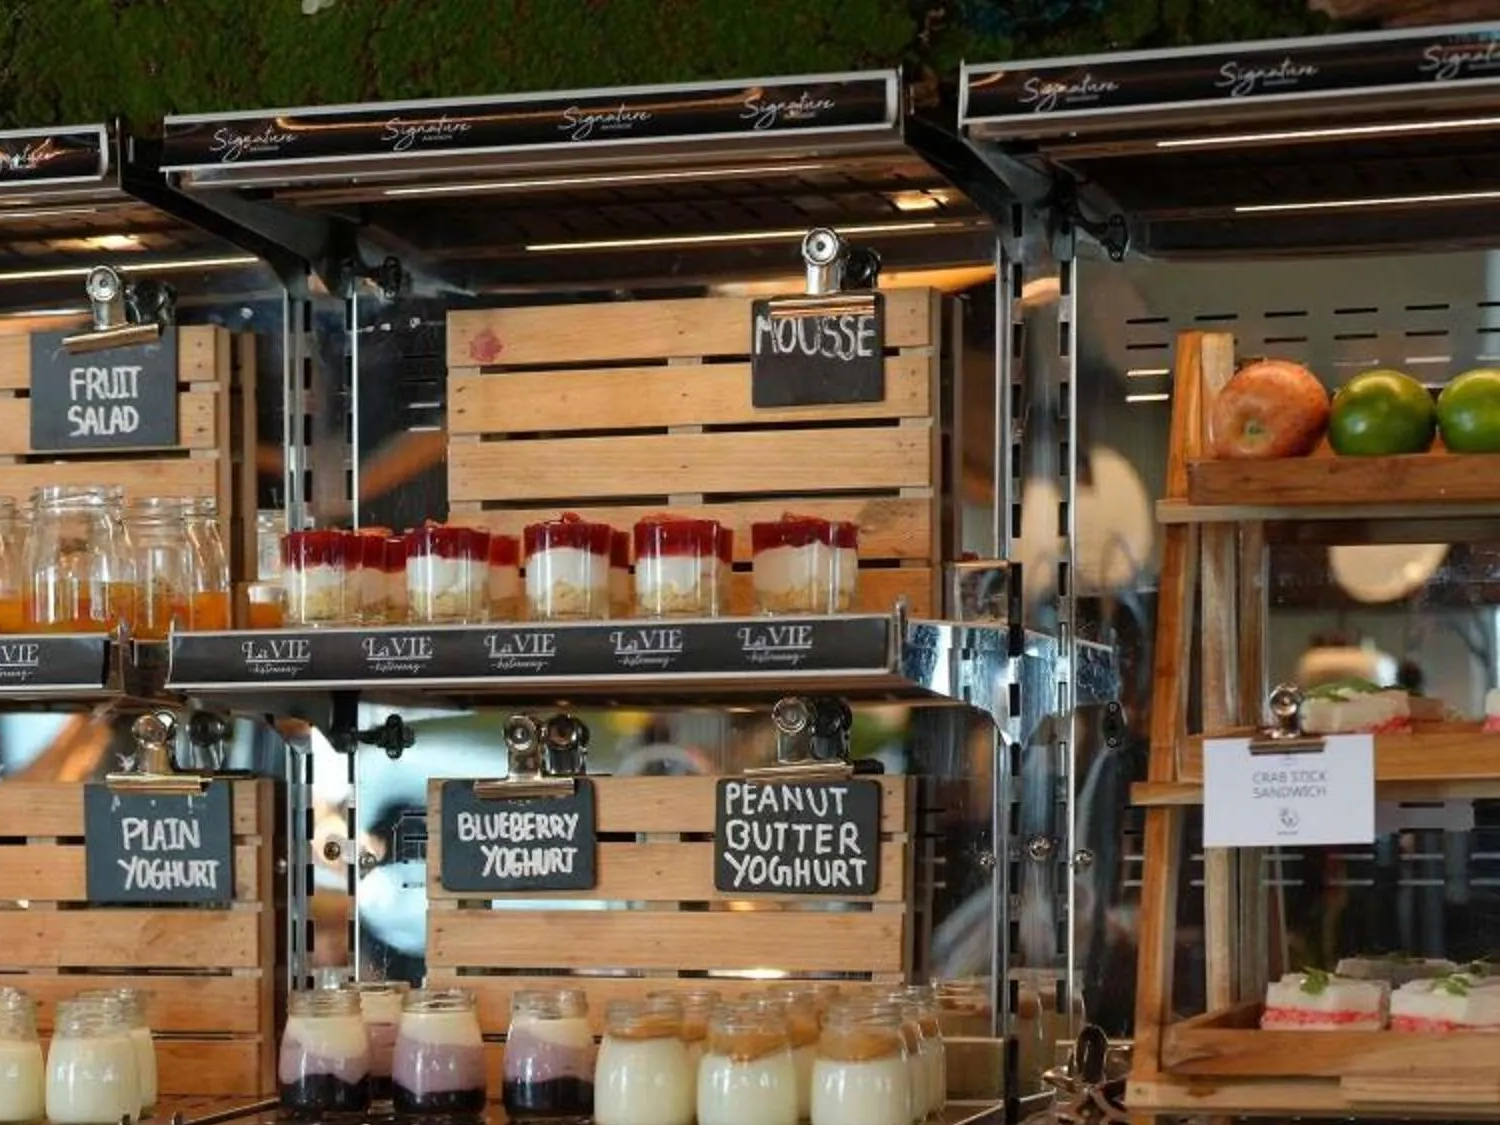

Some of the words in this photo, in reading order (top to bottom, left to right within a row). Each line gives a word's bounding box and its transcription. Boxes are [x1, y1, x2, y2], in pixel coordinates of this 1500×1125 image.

[1019, 76, 1119, 112] Signature
[1214, 60, 1319, 98] Signature
[210, 127, 297, 162] Signature
[381, 114, 472, 151] Signature
[557, 103, 651, 140] Signature
[740, 91, 835, 129] Signature
[756, 314, 876, 361] MOUSSE
[69, 366, 143, 401] FRUIT
[68, 405, 140, 436] SALAD
[1252, 771, 1288, 785] CRAB
[1290, 770, 1328, 783] STICK
[1252, 785, 1327, 799] SANDWICH
[725, 782, 848, 816] PEANUT
[121, 817, 201, 852] PLAIN
[457, 812, 579, 842] BLUEBERRY
[726, 819, 861, 855] BUTTER
[117, 858, 219, 890] YOGHURT
[480, 845, 578, 878] YOGHURT
[724, 852, 867, 888] YOGHURT
